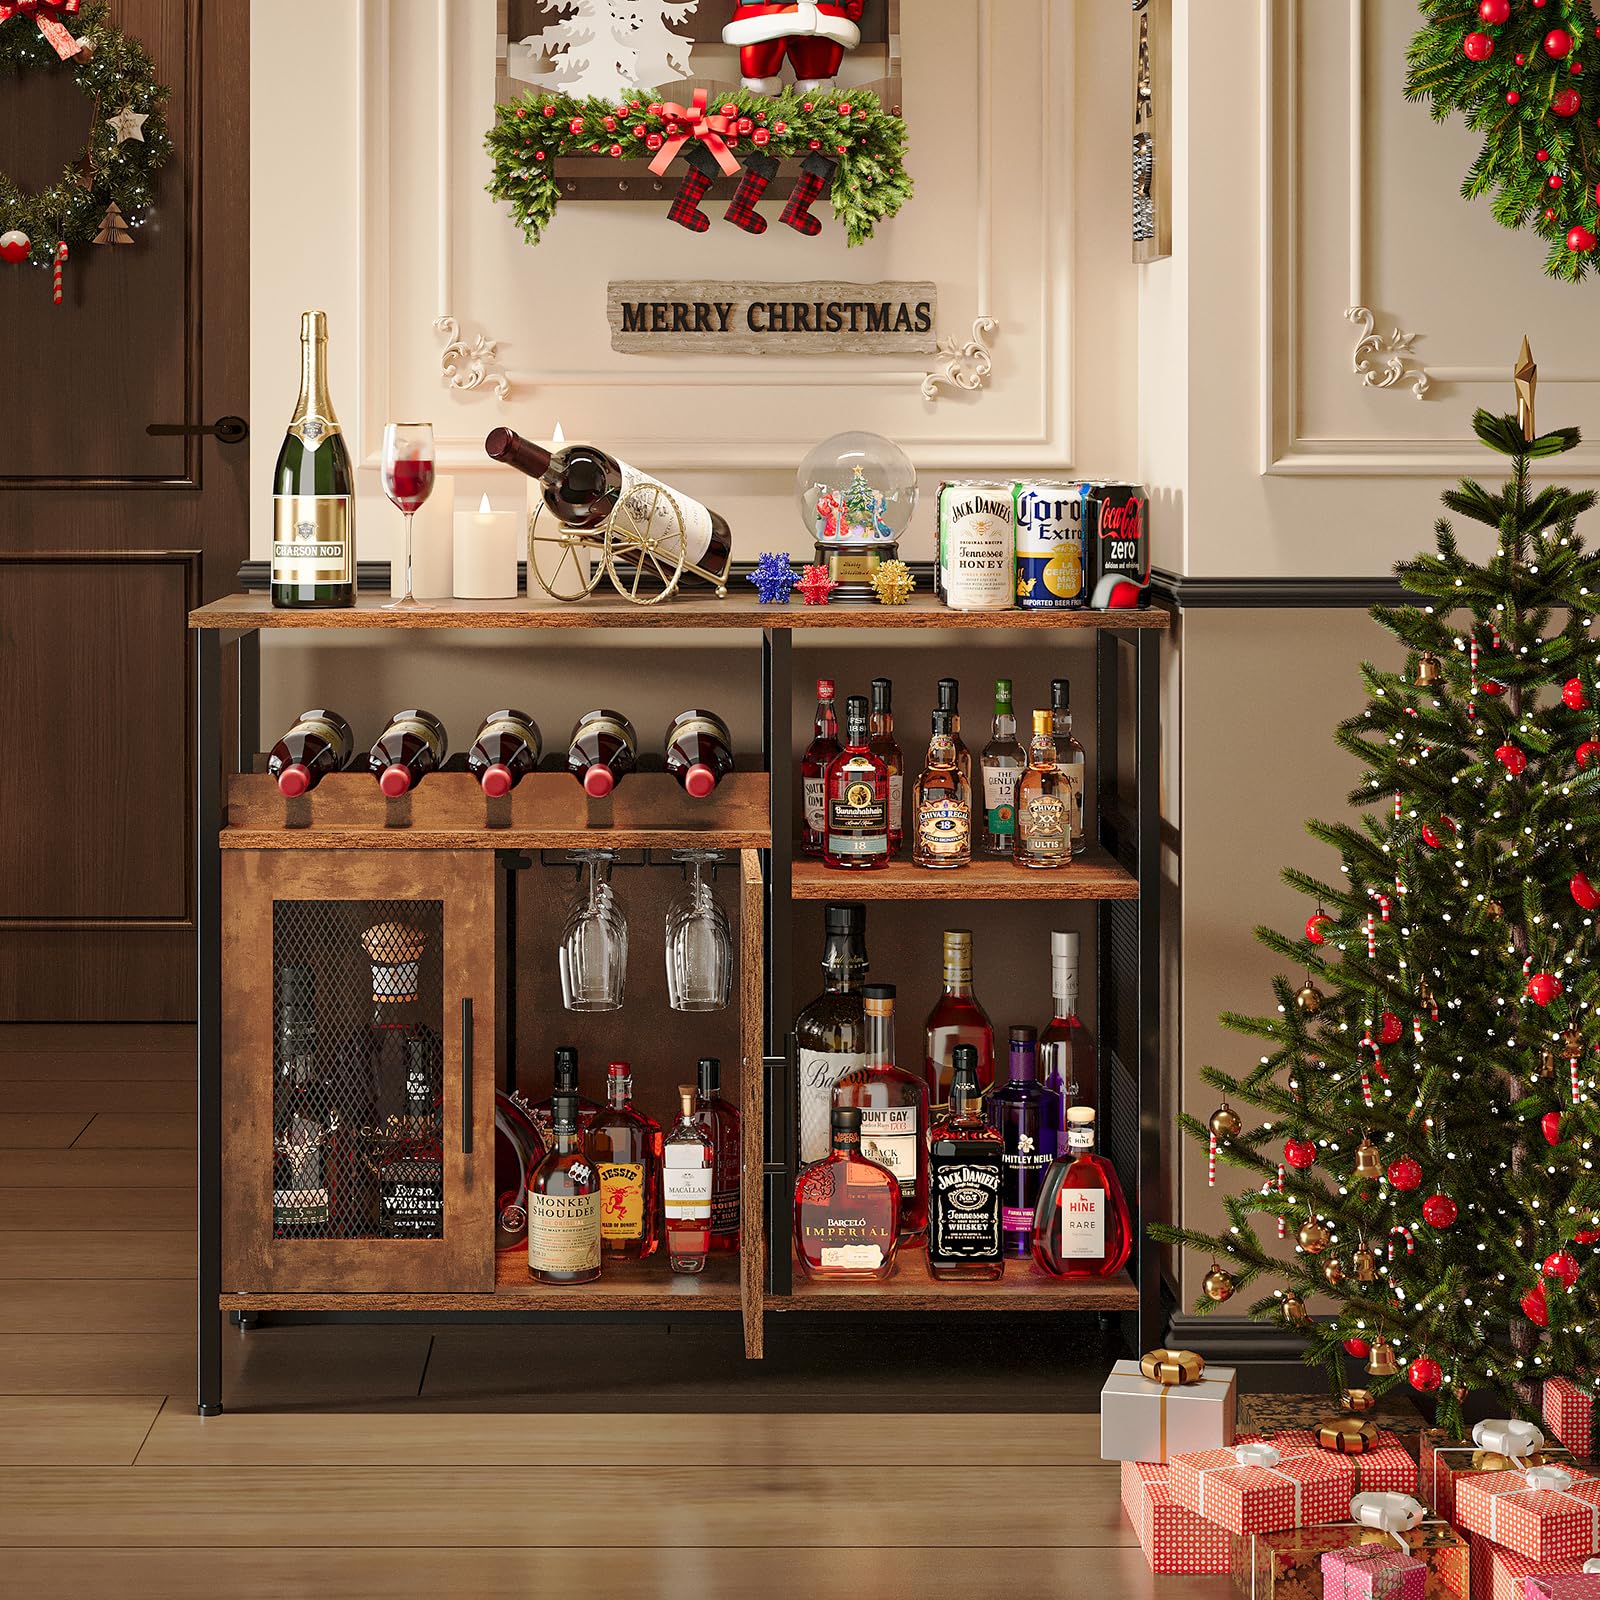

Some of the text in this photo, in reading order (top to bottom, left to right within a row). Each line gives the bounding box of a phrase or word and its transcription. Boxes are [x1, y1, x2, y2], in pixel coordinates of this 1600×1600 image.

[620, 302, 931, 333] MERRY CHRISTMAS
[952, 496, 1011, 523] JACK DANIEL'S
[1016, 491, 1082, 531] Coro
[275, 545, 341, 557] CHARSON NOD
[959, 547, 1004, 558] Tennessee
[1110, 541, 1136, 559] zero
[1023, 599, 1053, 607] IMPORTED
[1054, 599, 1070, 607] BEER
[989, 777, 1017, 785] GLENLIV
[999, 786, 1011, 795] 12
[835, 806, 882, 815] Bunnahabhain
[920, 811, 968, 820] CHIVAS REGAL
[1038, 815, 1055, 823] XX
[940, 820, 951, 829] 18
[853, 842, 866, 850] 18
[861, 1111, 908, 1122] OUNT GAY
[1033, 1154, 1053, 1164] NEILL
[601, 1168, 637, 1181] JESSIE
[938, 1167, 1001, 1192] JACK DANIEL'S
[536, 1196, 591, 1207] MONKEY
[533, 1206, 595, 1218] SHOULDER
[1070, 1202, 1095, 1212] HINE
[947, 1210, 989, 1220] Tennessee
[827, 1218, 866, 1228] BARCELÓ
[948, 1223, 989, 1231] WHISKEY
[1070, 1221, 1096, 1229] RARE
